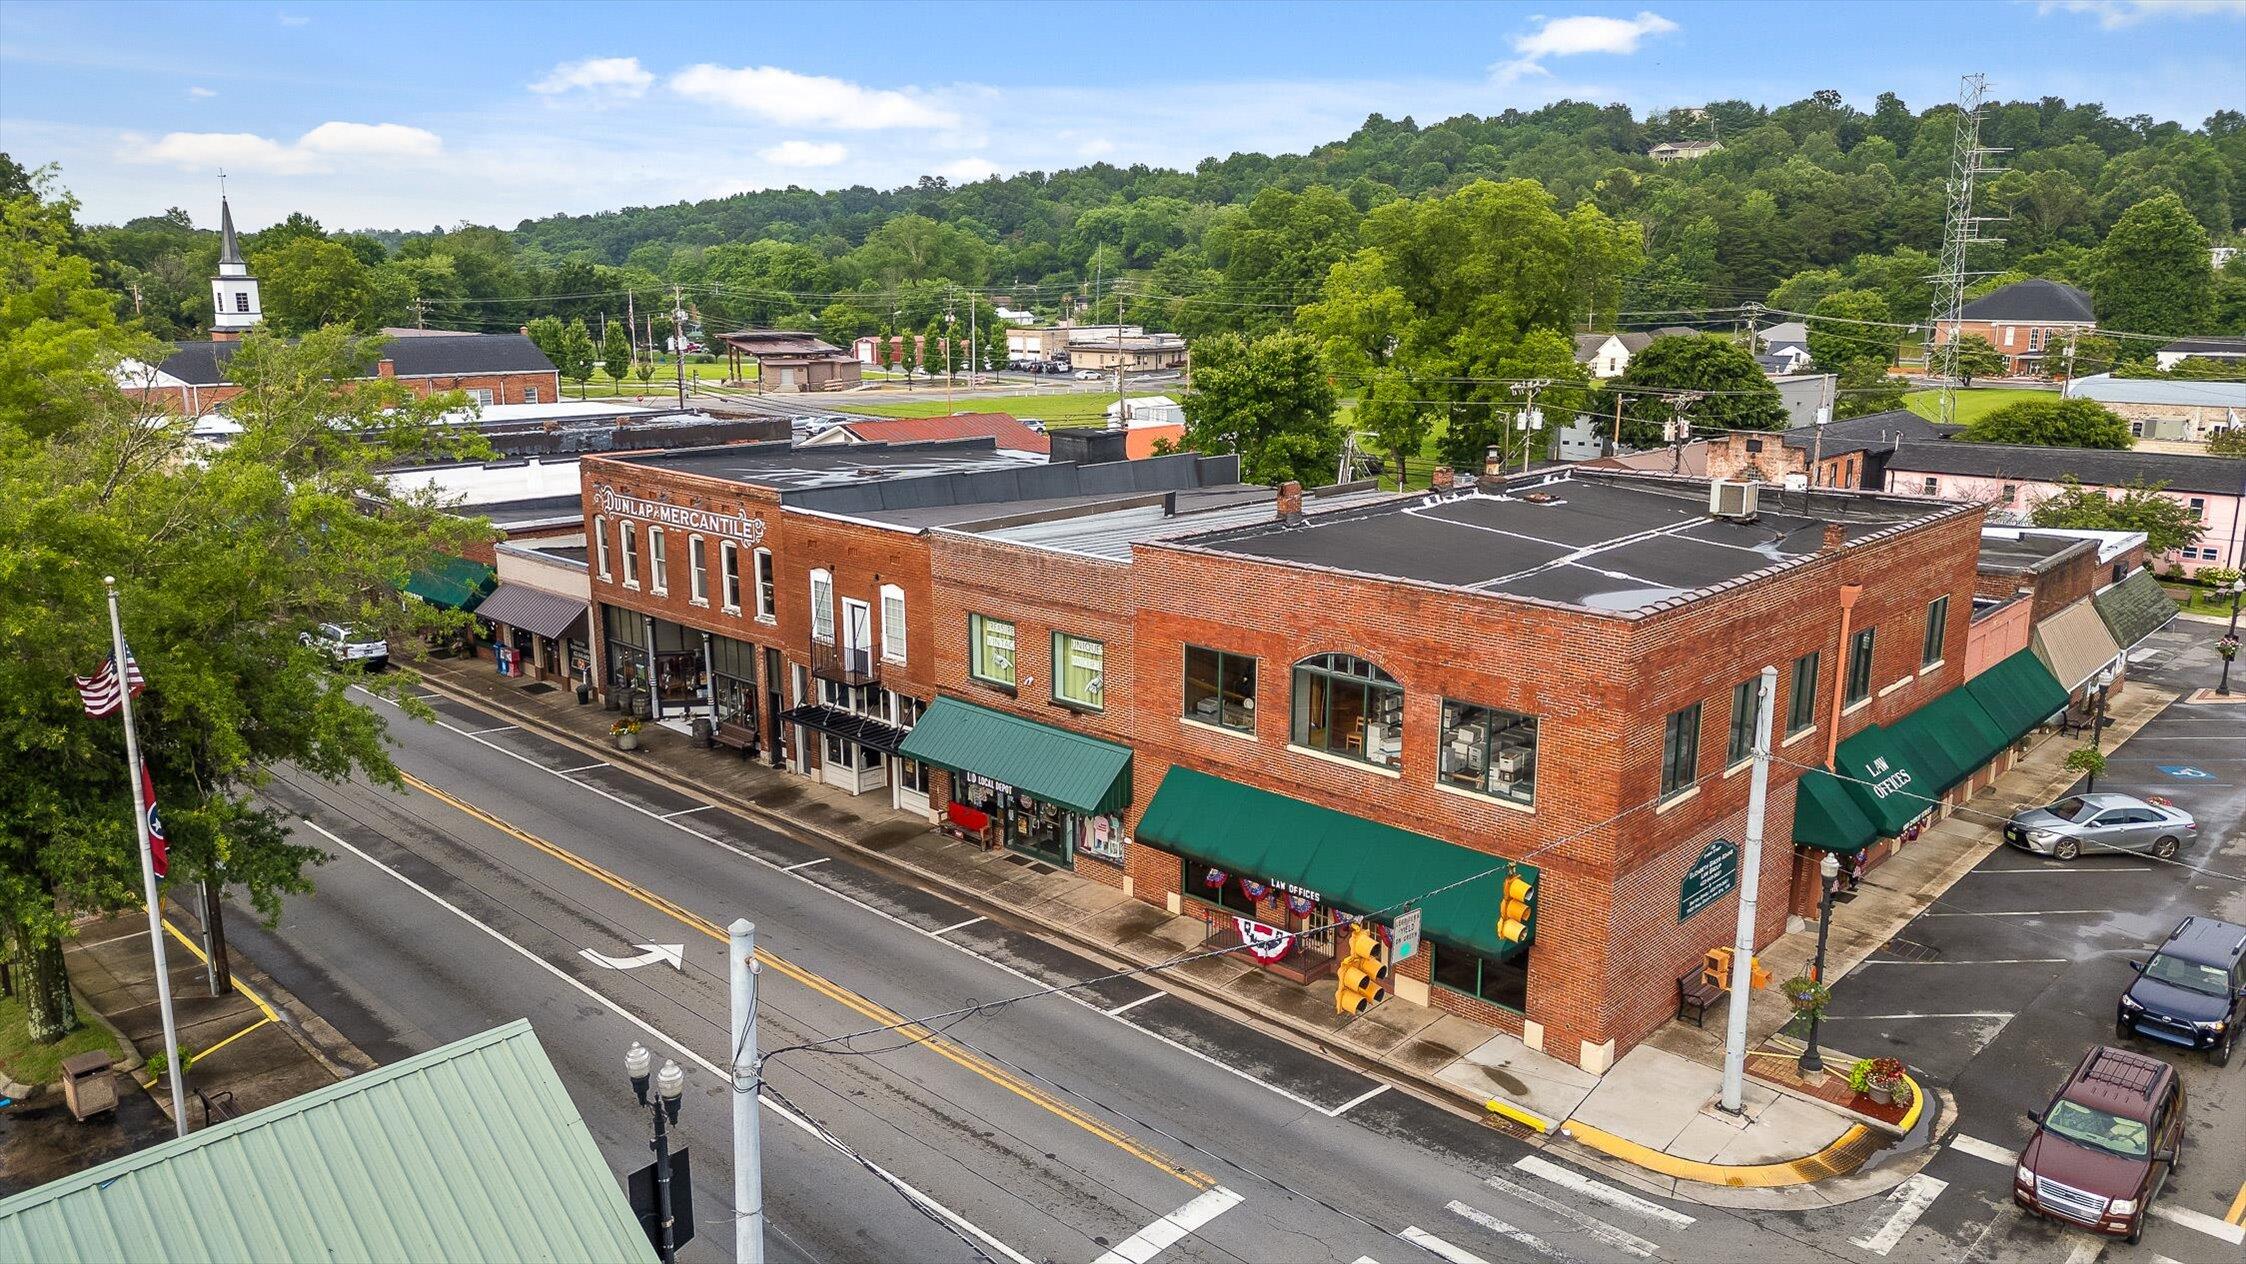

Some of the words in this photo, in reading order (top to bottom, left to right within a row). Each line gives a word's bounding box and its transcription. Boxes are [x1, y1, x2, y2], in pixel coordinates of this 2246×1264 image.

[603, 490, 654, 518] DUNLAP
[660, 506, 753, 539] MERCANTILE
[1865, 755, 1890, 778] LAW
[978, 776, 994, 789] LOCAL
[995, 781, 1013, 795] DEPOT
[1873, 768, 1912, 799] OFFICES
[1271, 877, 1286, 890] LAW
[1288, 883, 1321, 902] OFFICES
